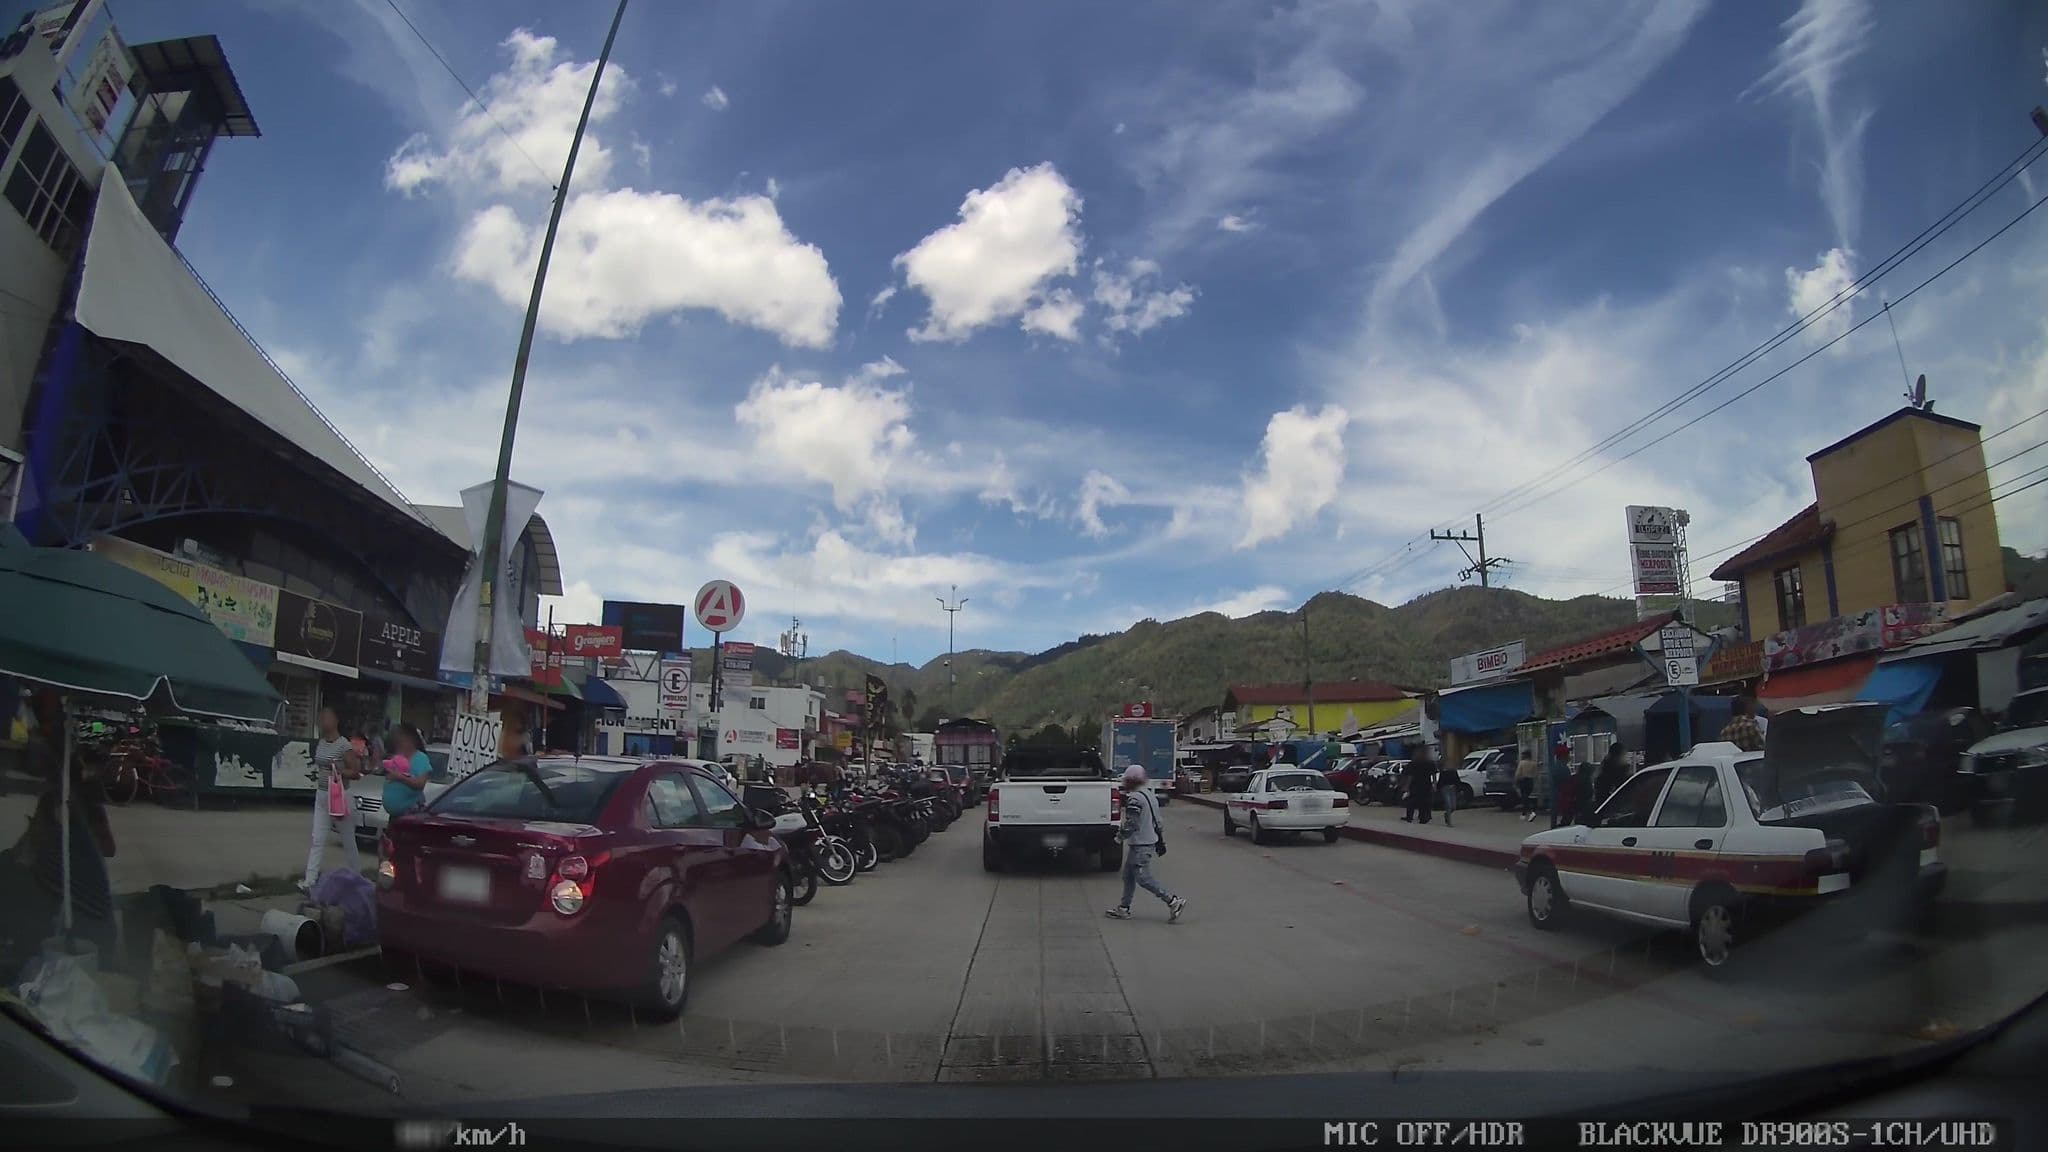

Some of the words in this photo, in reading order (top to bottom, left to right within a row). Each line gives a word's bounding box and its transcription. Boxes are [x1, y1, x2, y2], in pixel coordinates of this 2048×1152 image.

[381, 621, 421, 647] APPLE
[672, 673, 681, 690] E
[455, 714, 499, 753] FOTOS
